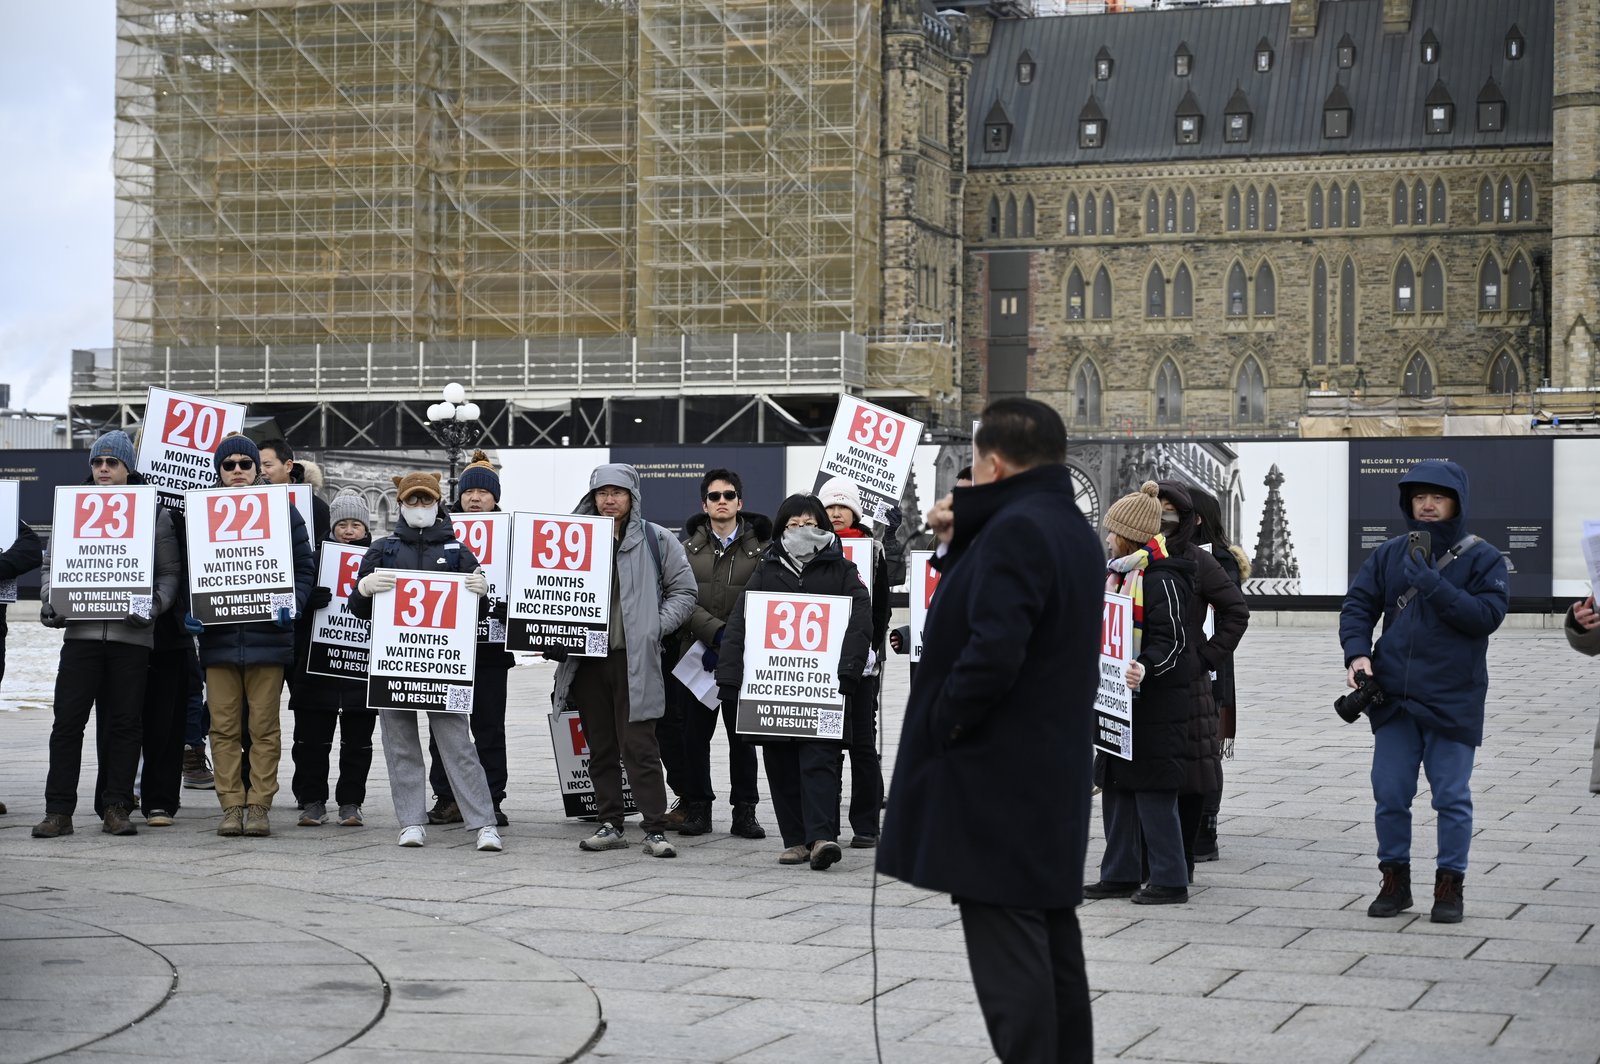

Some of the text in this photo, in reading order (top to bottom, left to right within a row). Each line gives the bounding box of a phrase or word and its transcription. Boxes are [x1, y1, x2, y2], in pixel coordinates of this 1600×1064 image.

[167, 401, 218, 450] 20
[854, 409, 898, 452] 39
[164, 450, 210, 468] MONTHS
[848, 446, 888, 468] MONTHS
[151, 460, 196, 478] WAITING
[836, 452, 896, 482] WAITING FOR
[826, 460, 898, 495] IRCC RESPONSE
[860, 490, 884, 503] ELINE
[860, 500, 877, 512] ULTS
[80, 494, 128, 538] 23
[214, 494, 264, 541] 22
[78, 544, 126, 555] MONTHS
[216, 546, 264, 558] MONTHS
[538, 522, 586, 570] 39
[66, 558, 138, 568] WAITING FOR
[204, 559, 278, 573] WAITING FOR
[58, 572, 144, 582] IRCC RESPONSE
[198, 572, 286, 588] IRCC RESPONSE
[343, 554, 364, 597] 3
[536, 575, 584, 588] MONTHS
[68, 592, 132, 600] NO TIMELINES
[210, 596, 223, 605] NO
[524, 588, 596, 603] WAITING FOR
[72, 602, 128, 612] NO RESULTS
[216, 604, 270, 616] NO RESULTS
[401, 580, 452, 627] 37
[516, 602, 540, 614] IRCC
[542, 604, 602, 618] RESPONSE
[328, 615, 372, 630] WAITING
[771, 602, 824, 650] 36
[320, 628, 370, 643] IRCC RESP
[526, 624, 589, 636] NO TIMELINES
[1103, 602, 1121, 658] 14
[399, 632, 448, 646] MONTHS
[529, 636, 542, 645] NO
[328, 648, 340, 658] NO
[386, 646, 460, 660] WAITING FOR
[330, 660, 369, 672] NO RESU
[378, 660, 466, 674] IRCC RESPONSE
[769, 656, 818, 668] MONTHS
[756, 670, 830, 684] WAITING FOR
[1102, 662, 1120, 678] MONTHS
[388, 680, 452, 693] NO TIMELINE
[747, 684, 837, 698] IRCC RESPONSE
[1100, 678, 1125, 697] AITING FOR
[392, 692, 405, 702] NO
[1105, 694, 1128, 714] RESPONSE
[757, 704, 770, 714] NO
[760, 716, 818, 729] NO RESULTS
[567, 780, 591, 790] IRCC
